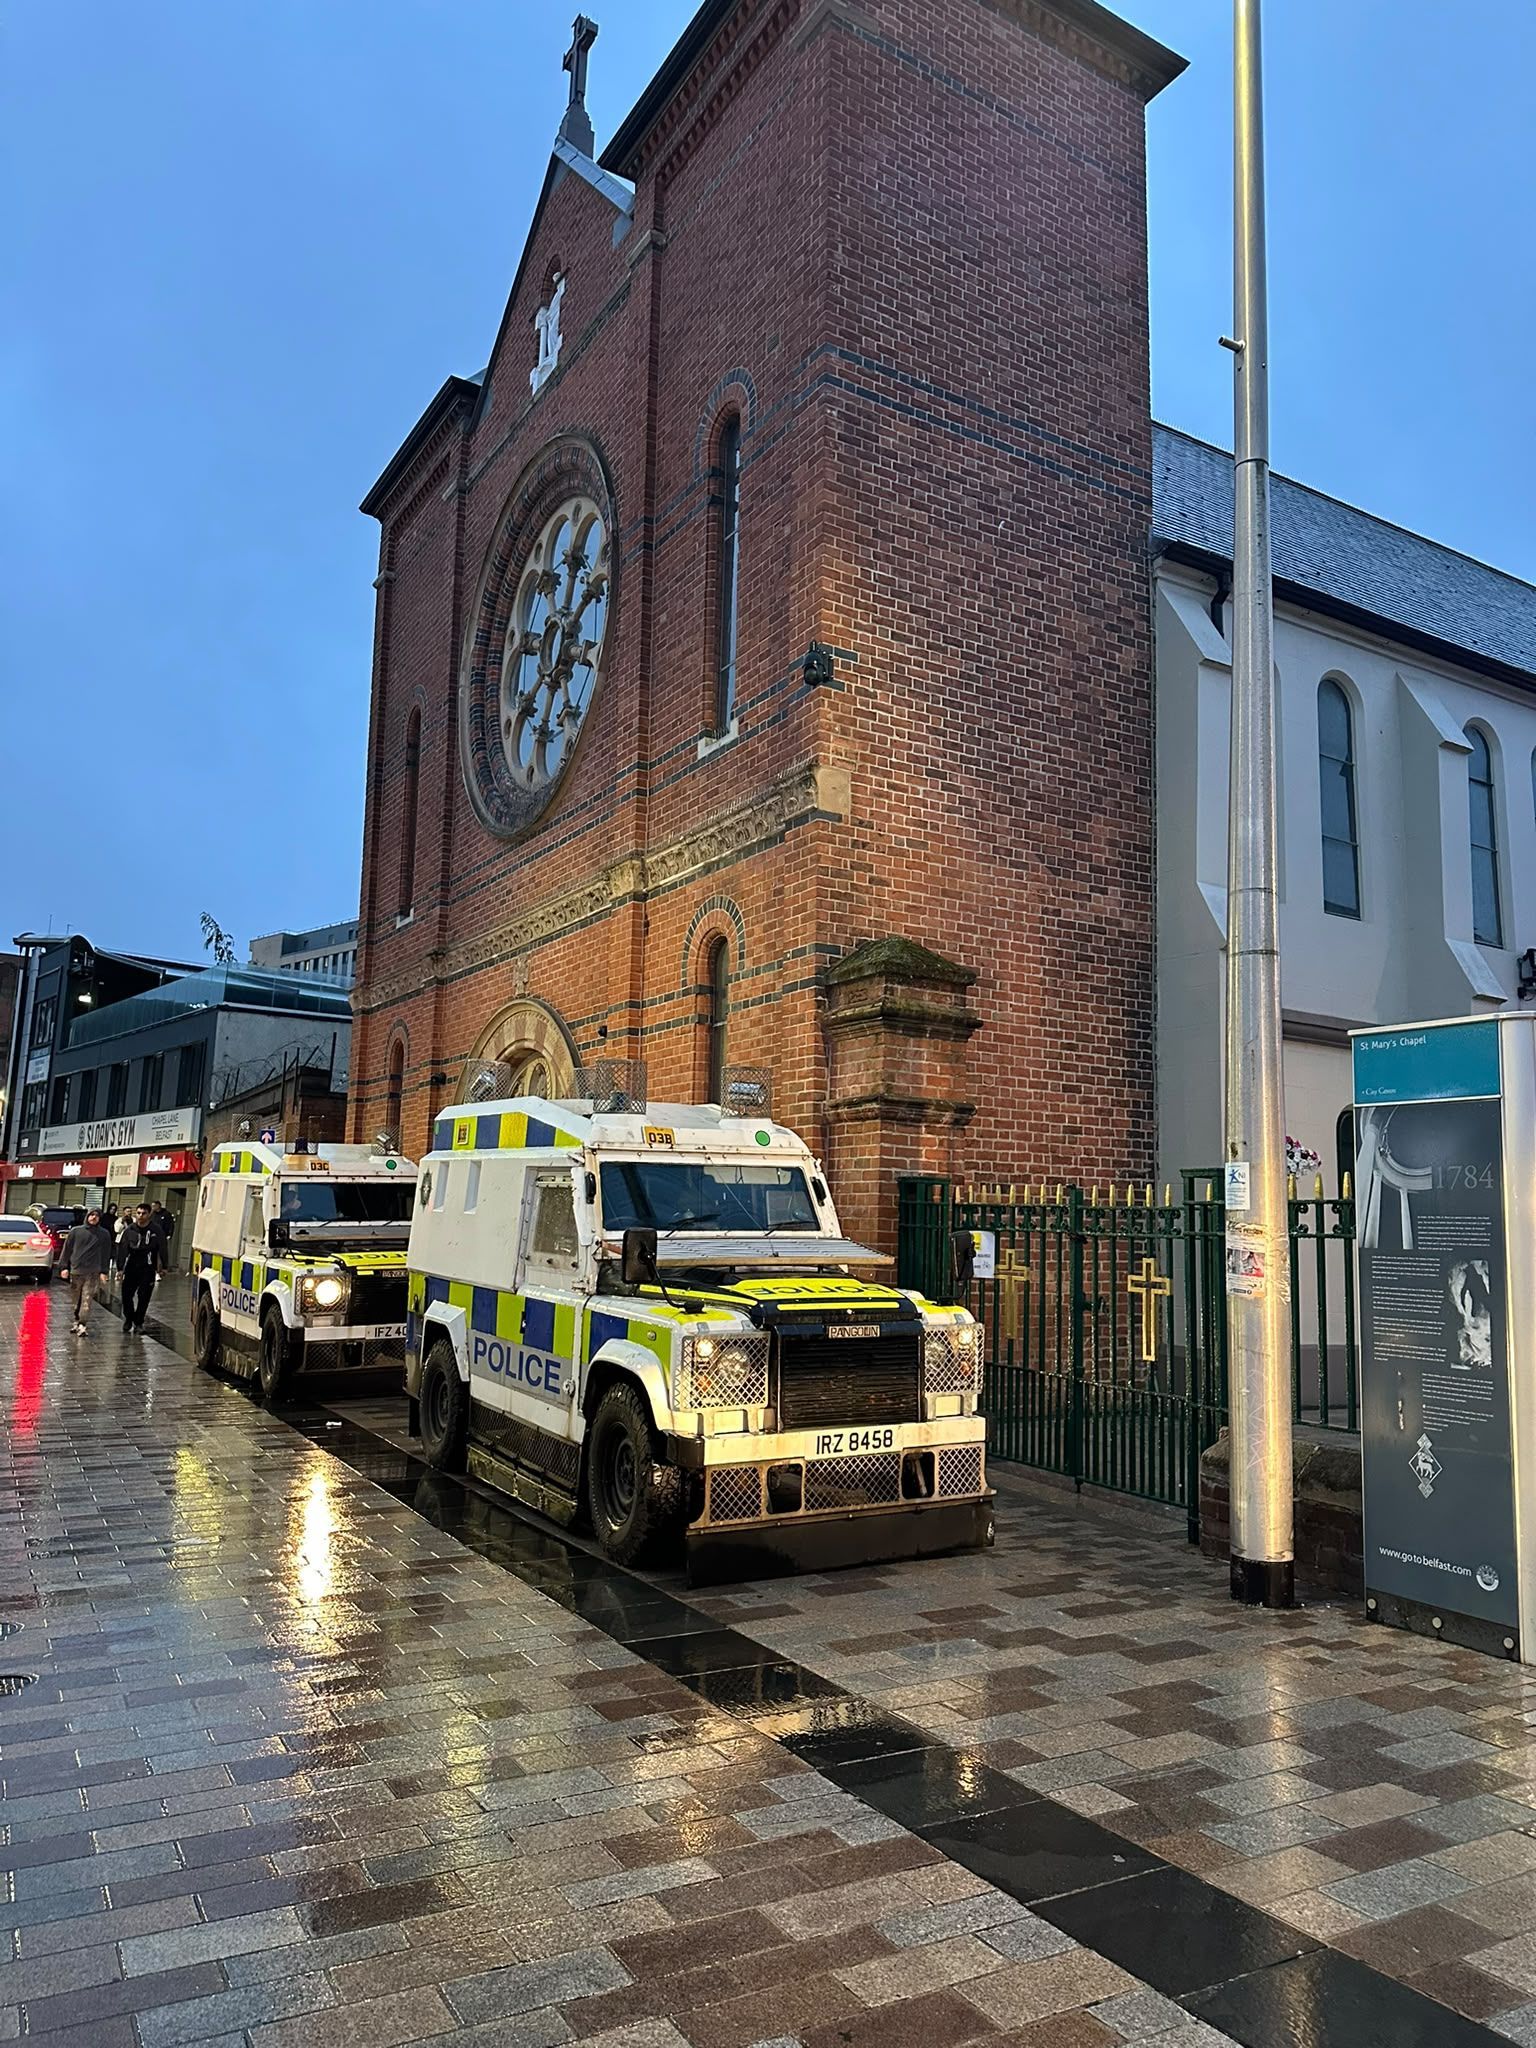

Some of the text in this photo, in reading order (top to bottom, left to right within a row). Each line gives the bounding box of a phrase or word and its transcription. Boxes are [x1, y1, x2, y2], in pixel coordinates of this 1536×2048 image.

[1360, 1034, 1427, 1051] St Mary's Chapel
[86, 1119, 136, 1150] SLOAN'S GYM
[1436, 1162, 1495, 1190] 1784
[222, 1287, 256, 1315] POLICE
[746, 1286, 890, 1295] POLICE
[374, 1326, 393, 1338] IFZ
[473, 1336, 561, 1395] POLICE
[816, 1429, 893, 1455] IRZ 8458
